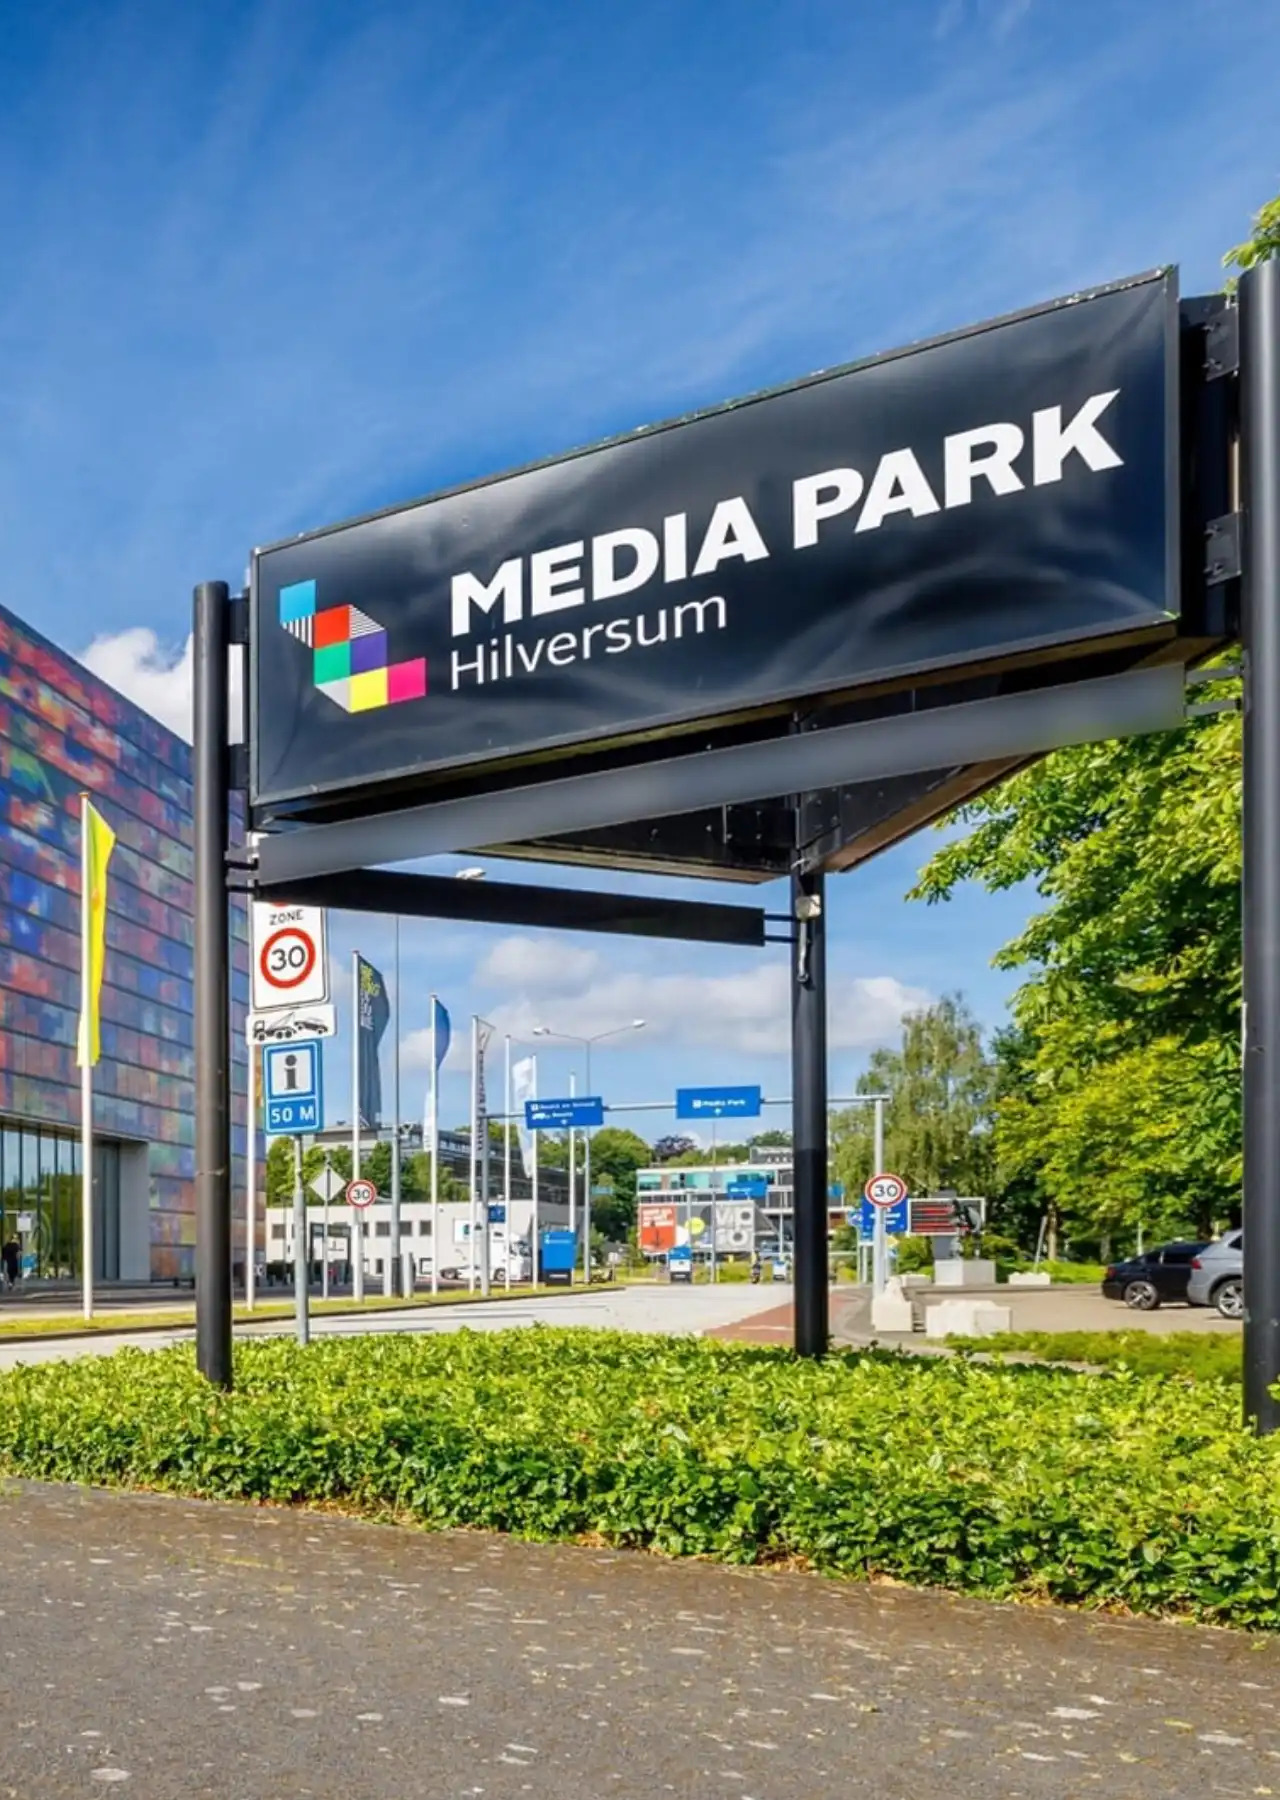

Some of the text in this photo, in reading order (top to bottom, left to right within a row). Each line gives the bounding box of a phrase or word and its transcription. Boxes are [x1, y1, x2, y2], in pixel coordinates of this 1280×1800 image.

[450, 390, 1124, 637] MEDIA PARK
[451, 596, 728, 691] Hilversum
[269, 909, 304, 926] ZONE
[270, 945, 306, 971] 30
[271, 1104, 315, 1124] 50 M
[353, 1188, 370, 1200] 30
[875, 1184, 899, 1198] 30
